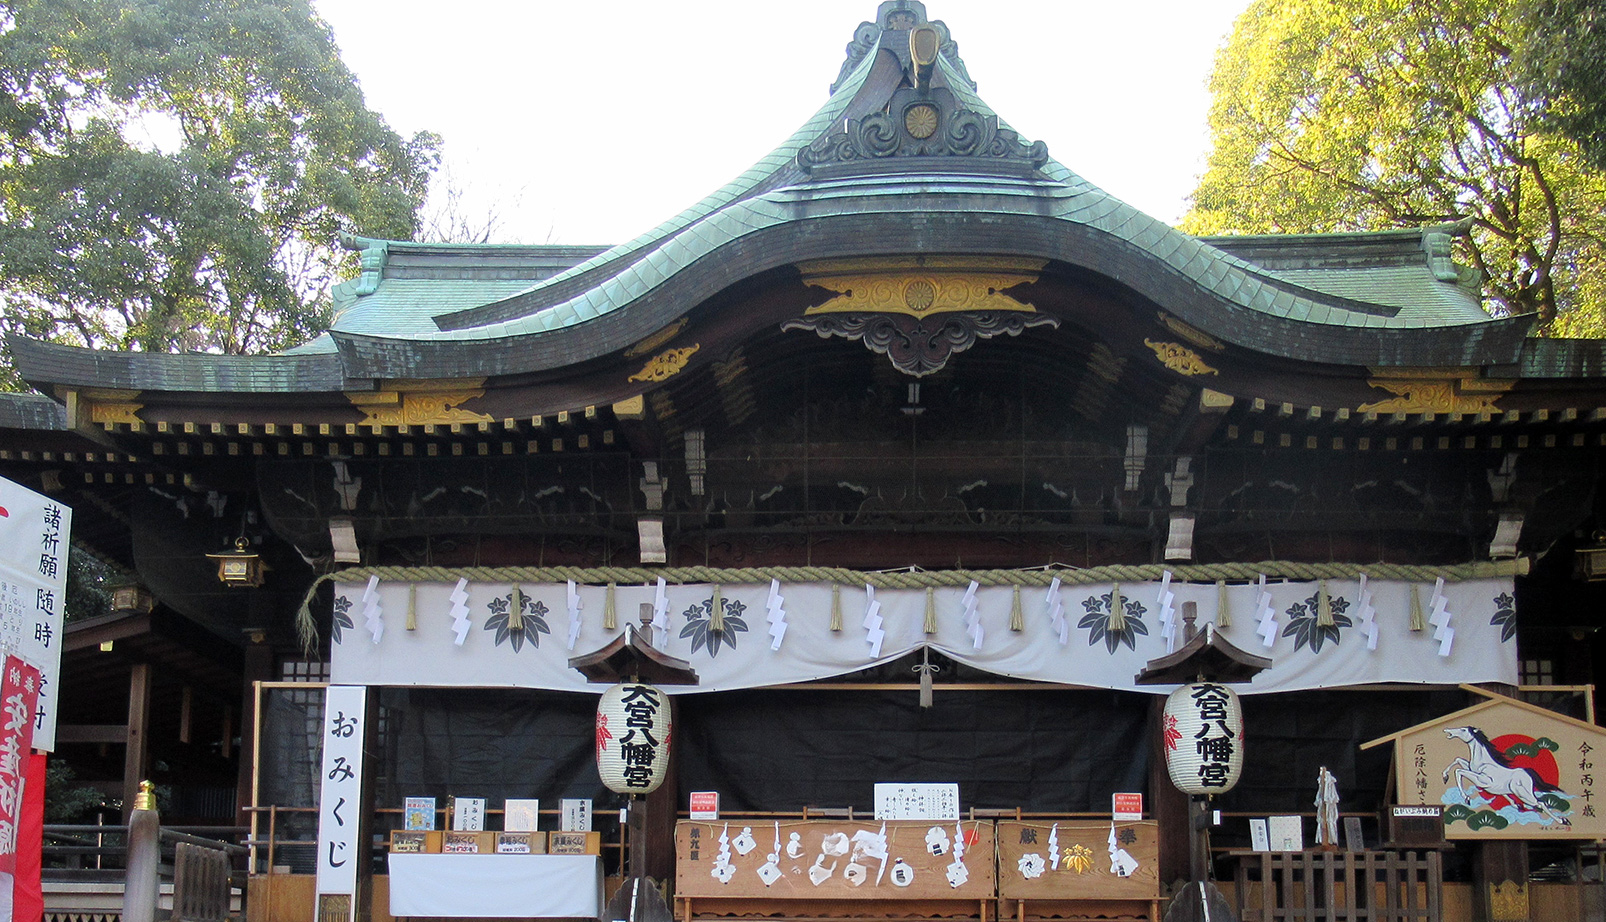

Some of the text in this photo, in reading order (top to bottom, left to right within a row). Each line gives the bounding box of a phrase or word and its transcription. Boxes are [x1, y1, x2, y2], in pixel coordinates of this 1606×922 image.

[619, 685, 661, 788] 大宮八幡宮
[1191, 683, 1235, 787] 大宮八幡宮
[1414, 744, 1428, 806] 厄除八幡さ
[1577, 741, 1597, 818] 令和丙午歳
[328, 711, 358, 868] おみくじ
[470, 799, 478, 830] おみくじ
